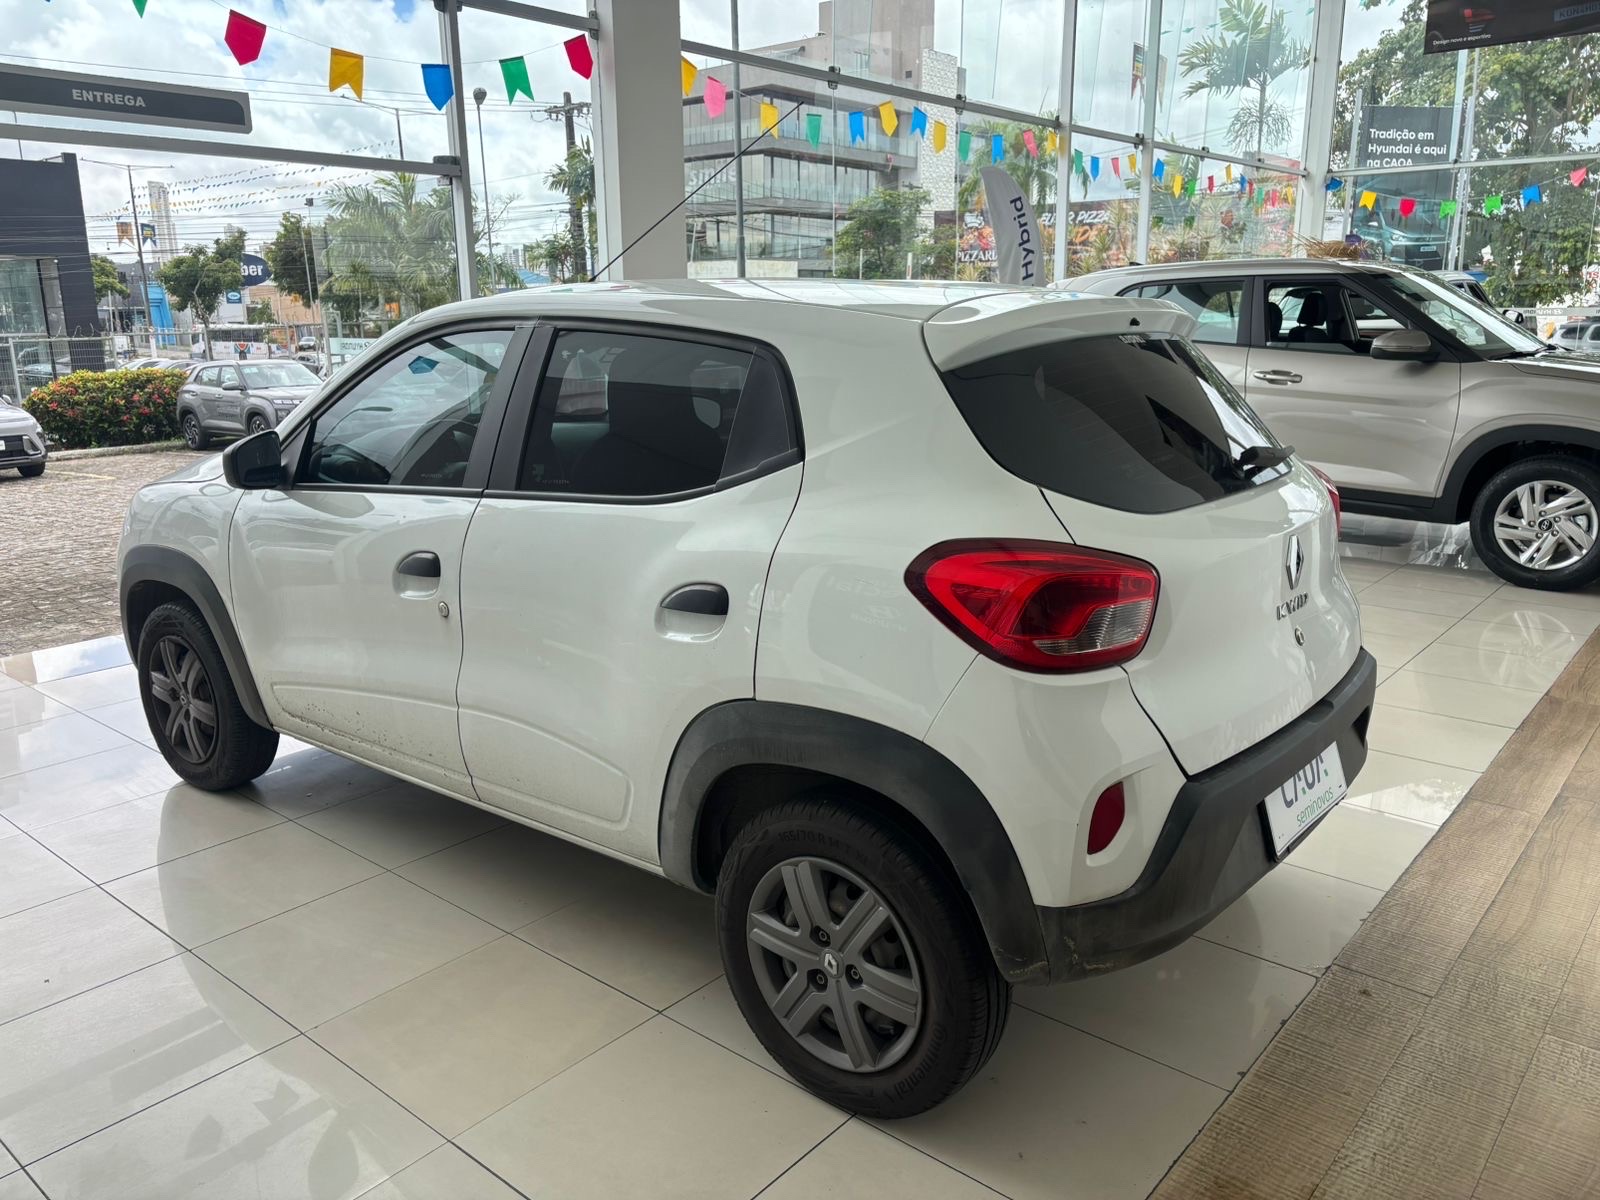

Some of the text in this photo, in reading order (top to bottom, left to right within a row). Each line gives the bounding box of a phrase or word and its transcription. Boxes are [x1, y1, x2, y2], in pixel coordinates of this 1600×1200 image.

[1432, 38, 1450, 46] Design
[1467, 33, 1492, 41] esportivo
[72, 88, 147, 107] ENTREGA
[1369, 128, 1435, 141] Tradição em
[1368, 143, 1447, 156] Hyundai é aqui
[1366, 159, 1381, 168] na
[1010, 196, 1035, 281] Hybrid
[1296, 787, 1334, 827] seminovos
